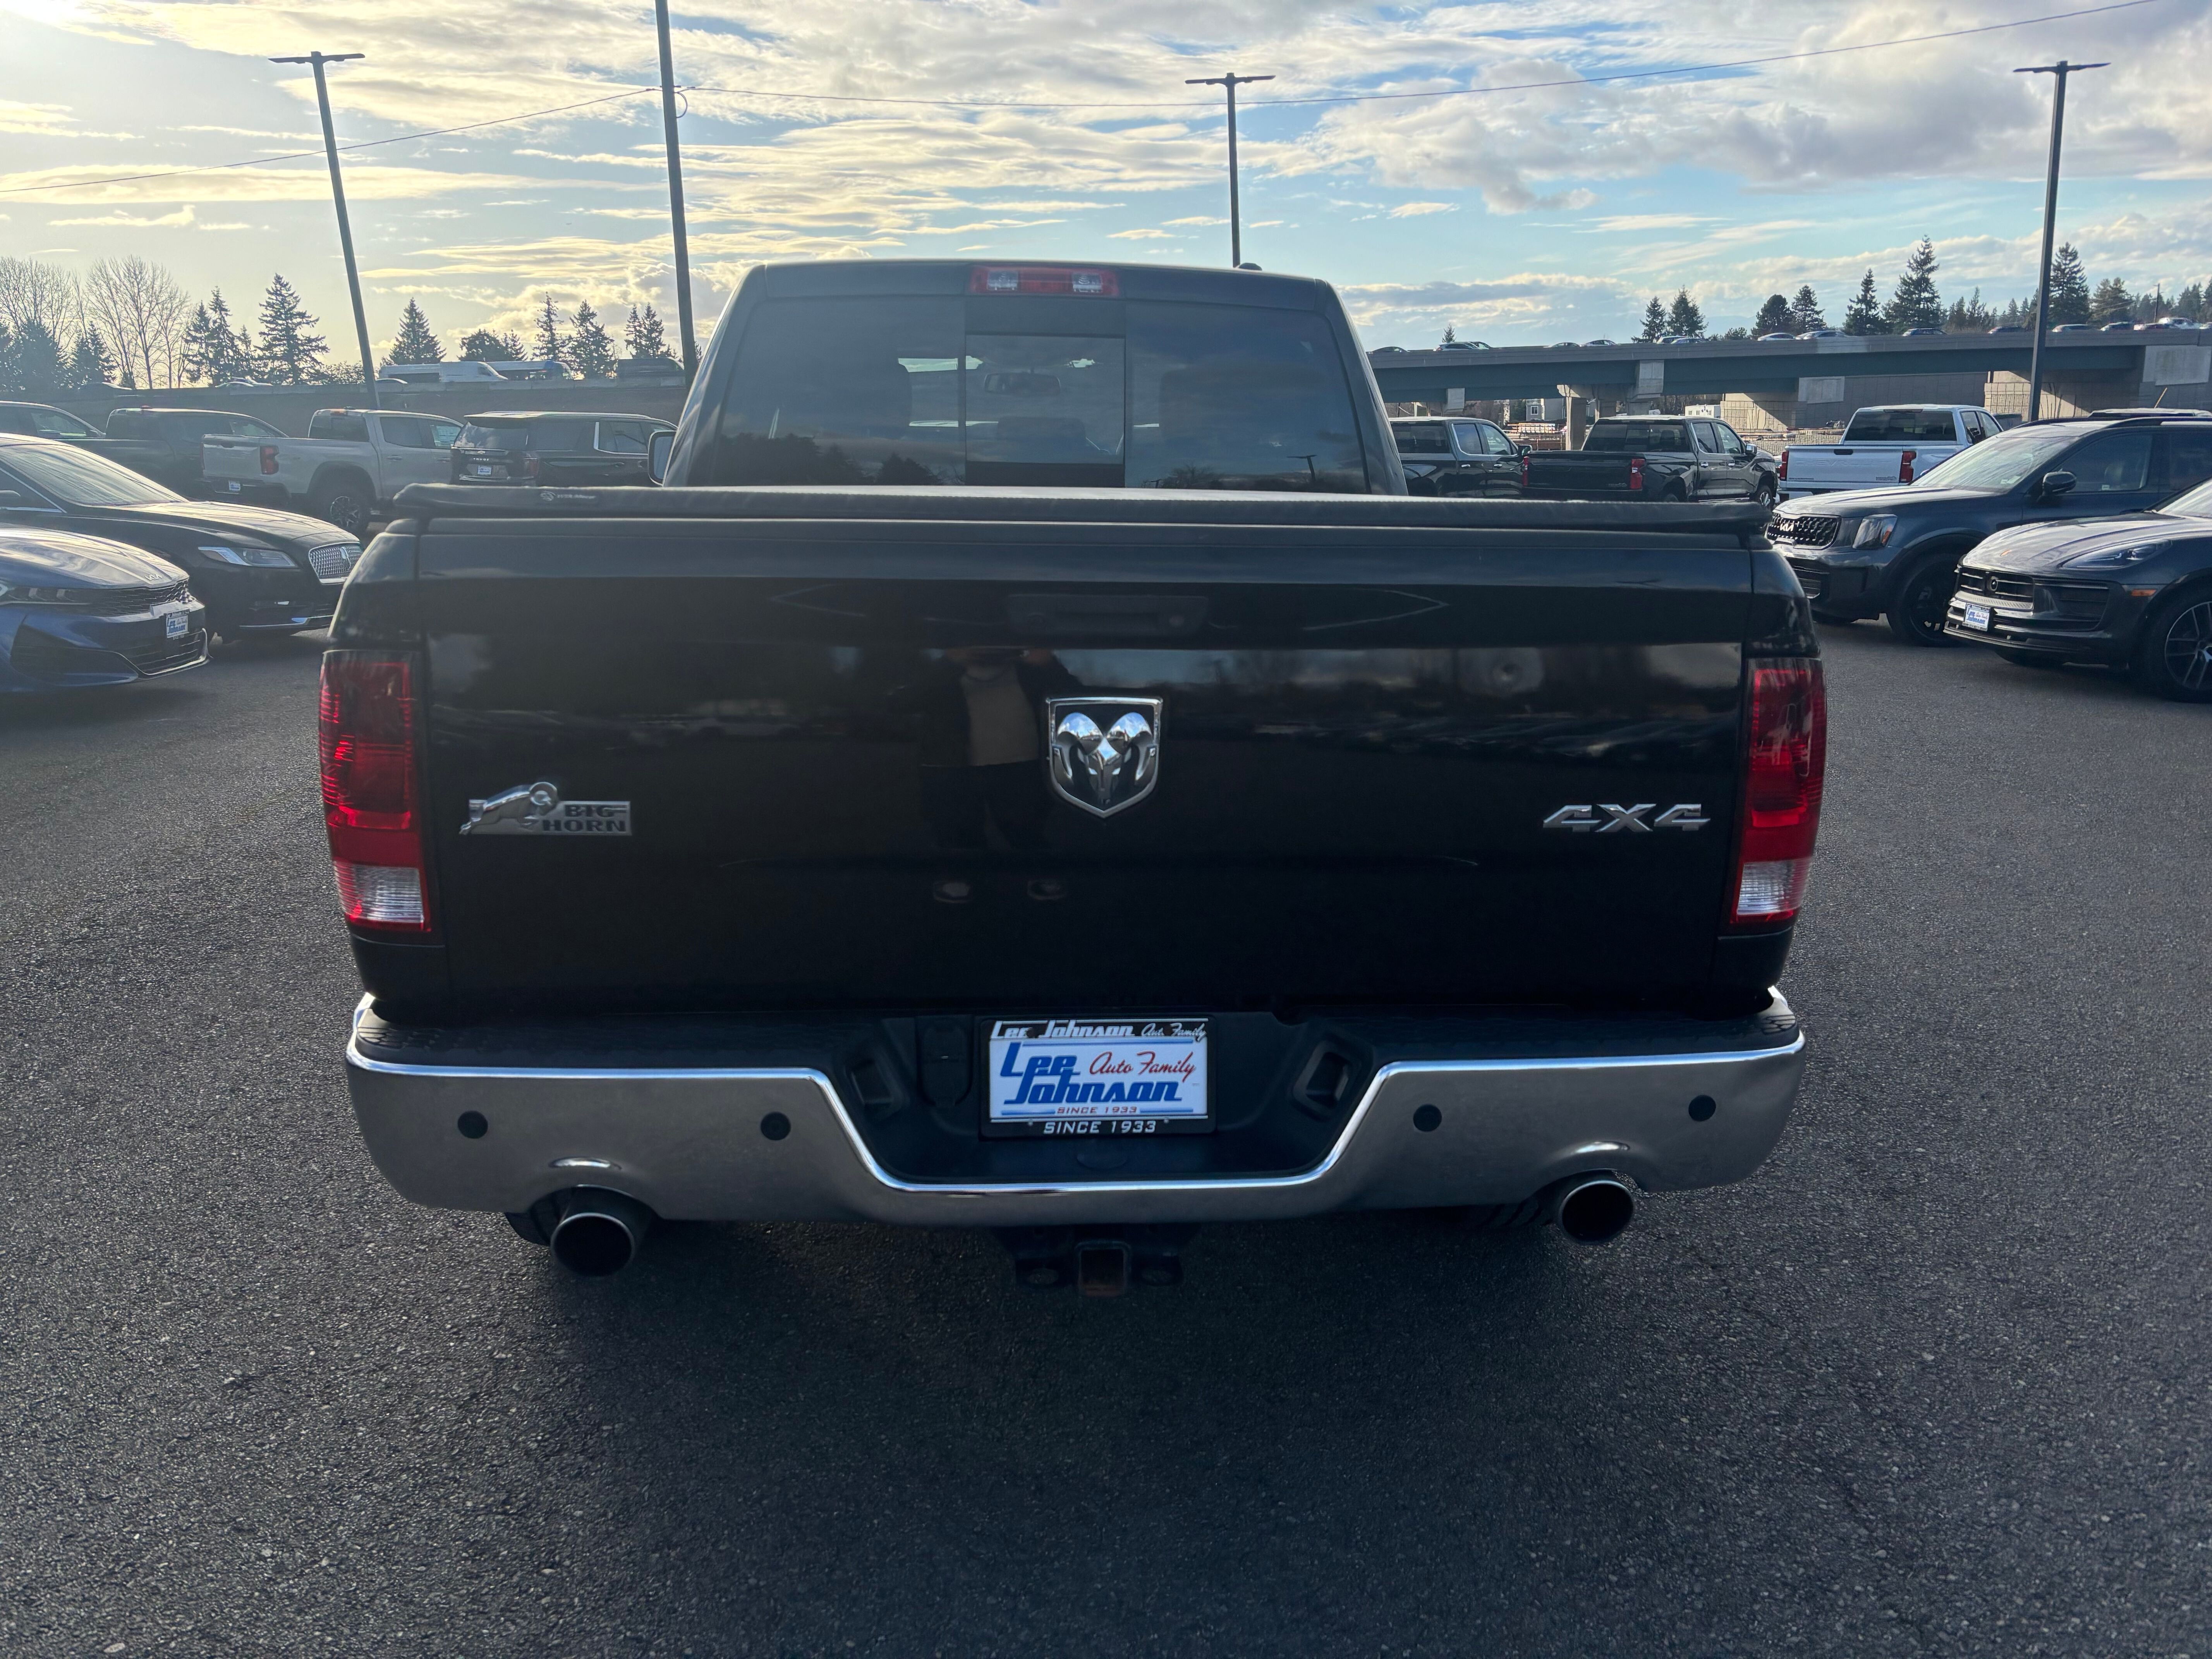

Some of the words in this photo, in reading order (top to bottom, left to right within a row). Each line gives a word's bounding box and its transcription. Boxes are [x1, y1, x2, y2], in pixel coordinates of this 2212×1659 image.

[565, 804, 627, 817] BIG
[543, 819, 627, 832] HORN
[1038, 1019, 1135, 1038] Johnson
[1141, 1023, 1164, 1036] Aut
[1170, 1022, 1207, 1041] Family
[1000, 1042, 1081, 1077] Lee
[1089, 1051, 1134, 1075] Auto
[1136, 1051, 1197, 1083] Family
[1004, 1066, 1182, 1104] Johnson
[1043, 1121, 1100, 1134] SINCE
[1111, 1120, 1156, 1133] 1933
